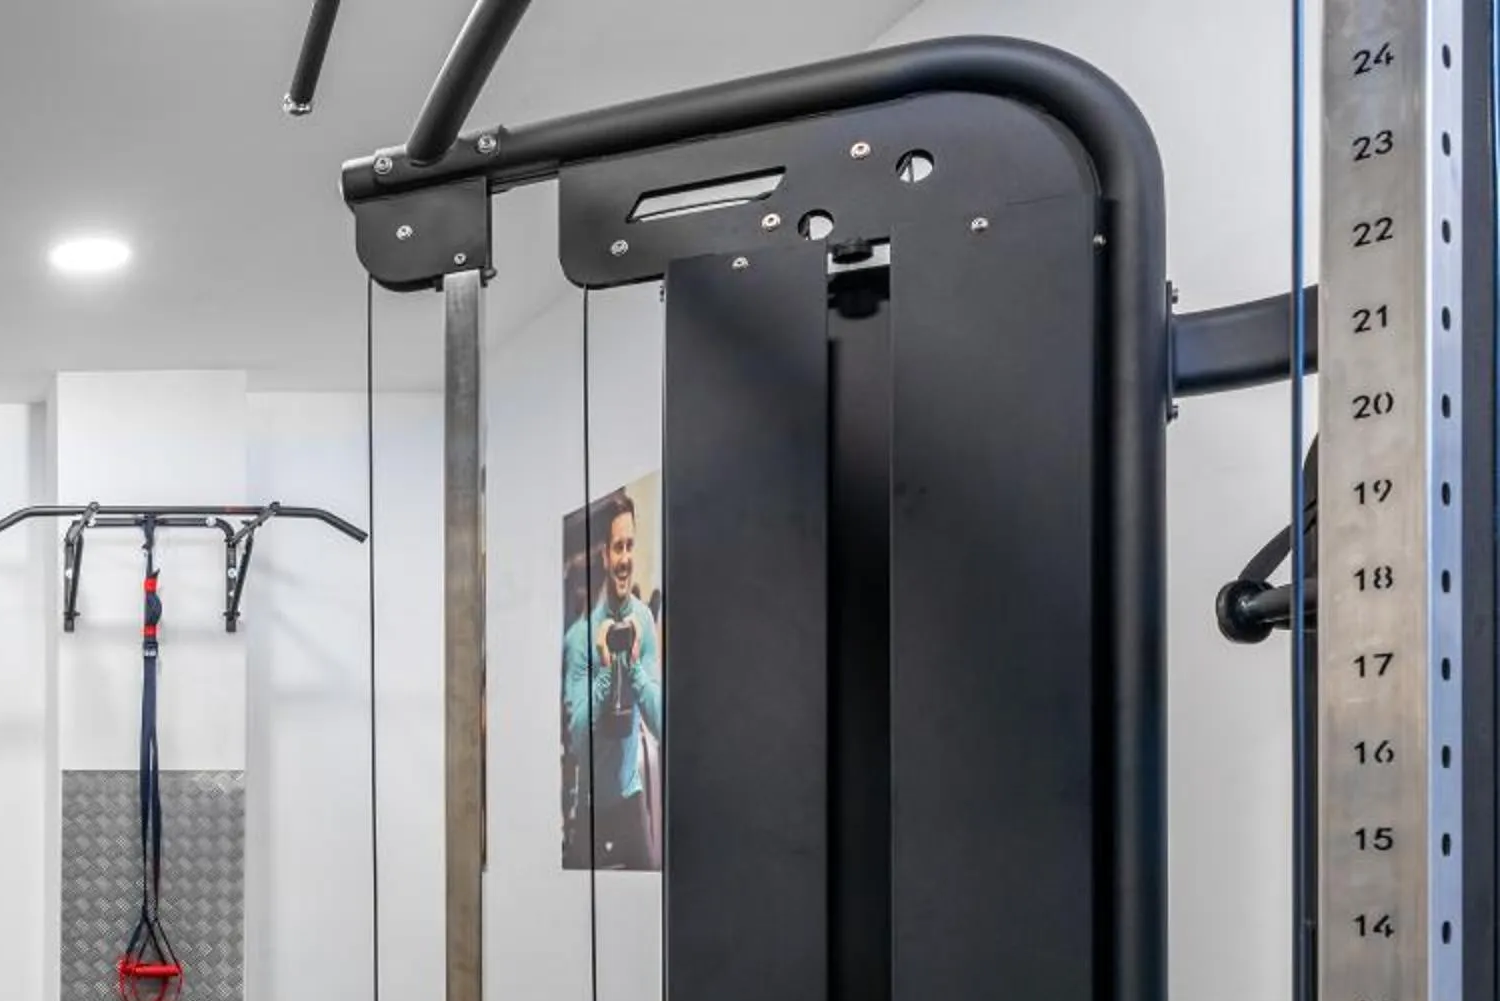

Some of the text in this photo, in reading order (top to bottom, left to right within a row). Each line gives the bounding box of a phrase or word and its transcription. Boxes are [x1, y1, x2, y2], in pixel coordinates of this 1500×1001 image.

[1353, 43, 1394, 76] 24
[1353, 130, 1393, 161] 23
[1353, 217, 1393, 247] 22
[1352, 305, 1389, 334] 21
[1352, 392, 1394, 420] 20
[1353, 479, 1393, 505] 19
[1353, 566, 1394, 592] 18
[1354, 652, 1394, 678] 17
[1354, 740, 1395, 765] 16
[1355, 827, 1394, 852] 15
[1354, 914, 1395, 939] 14
